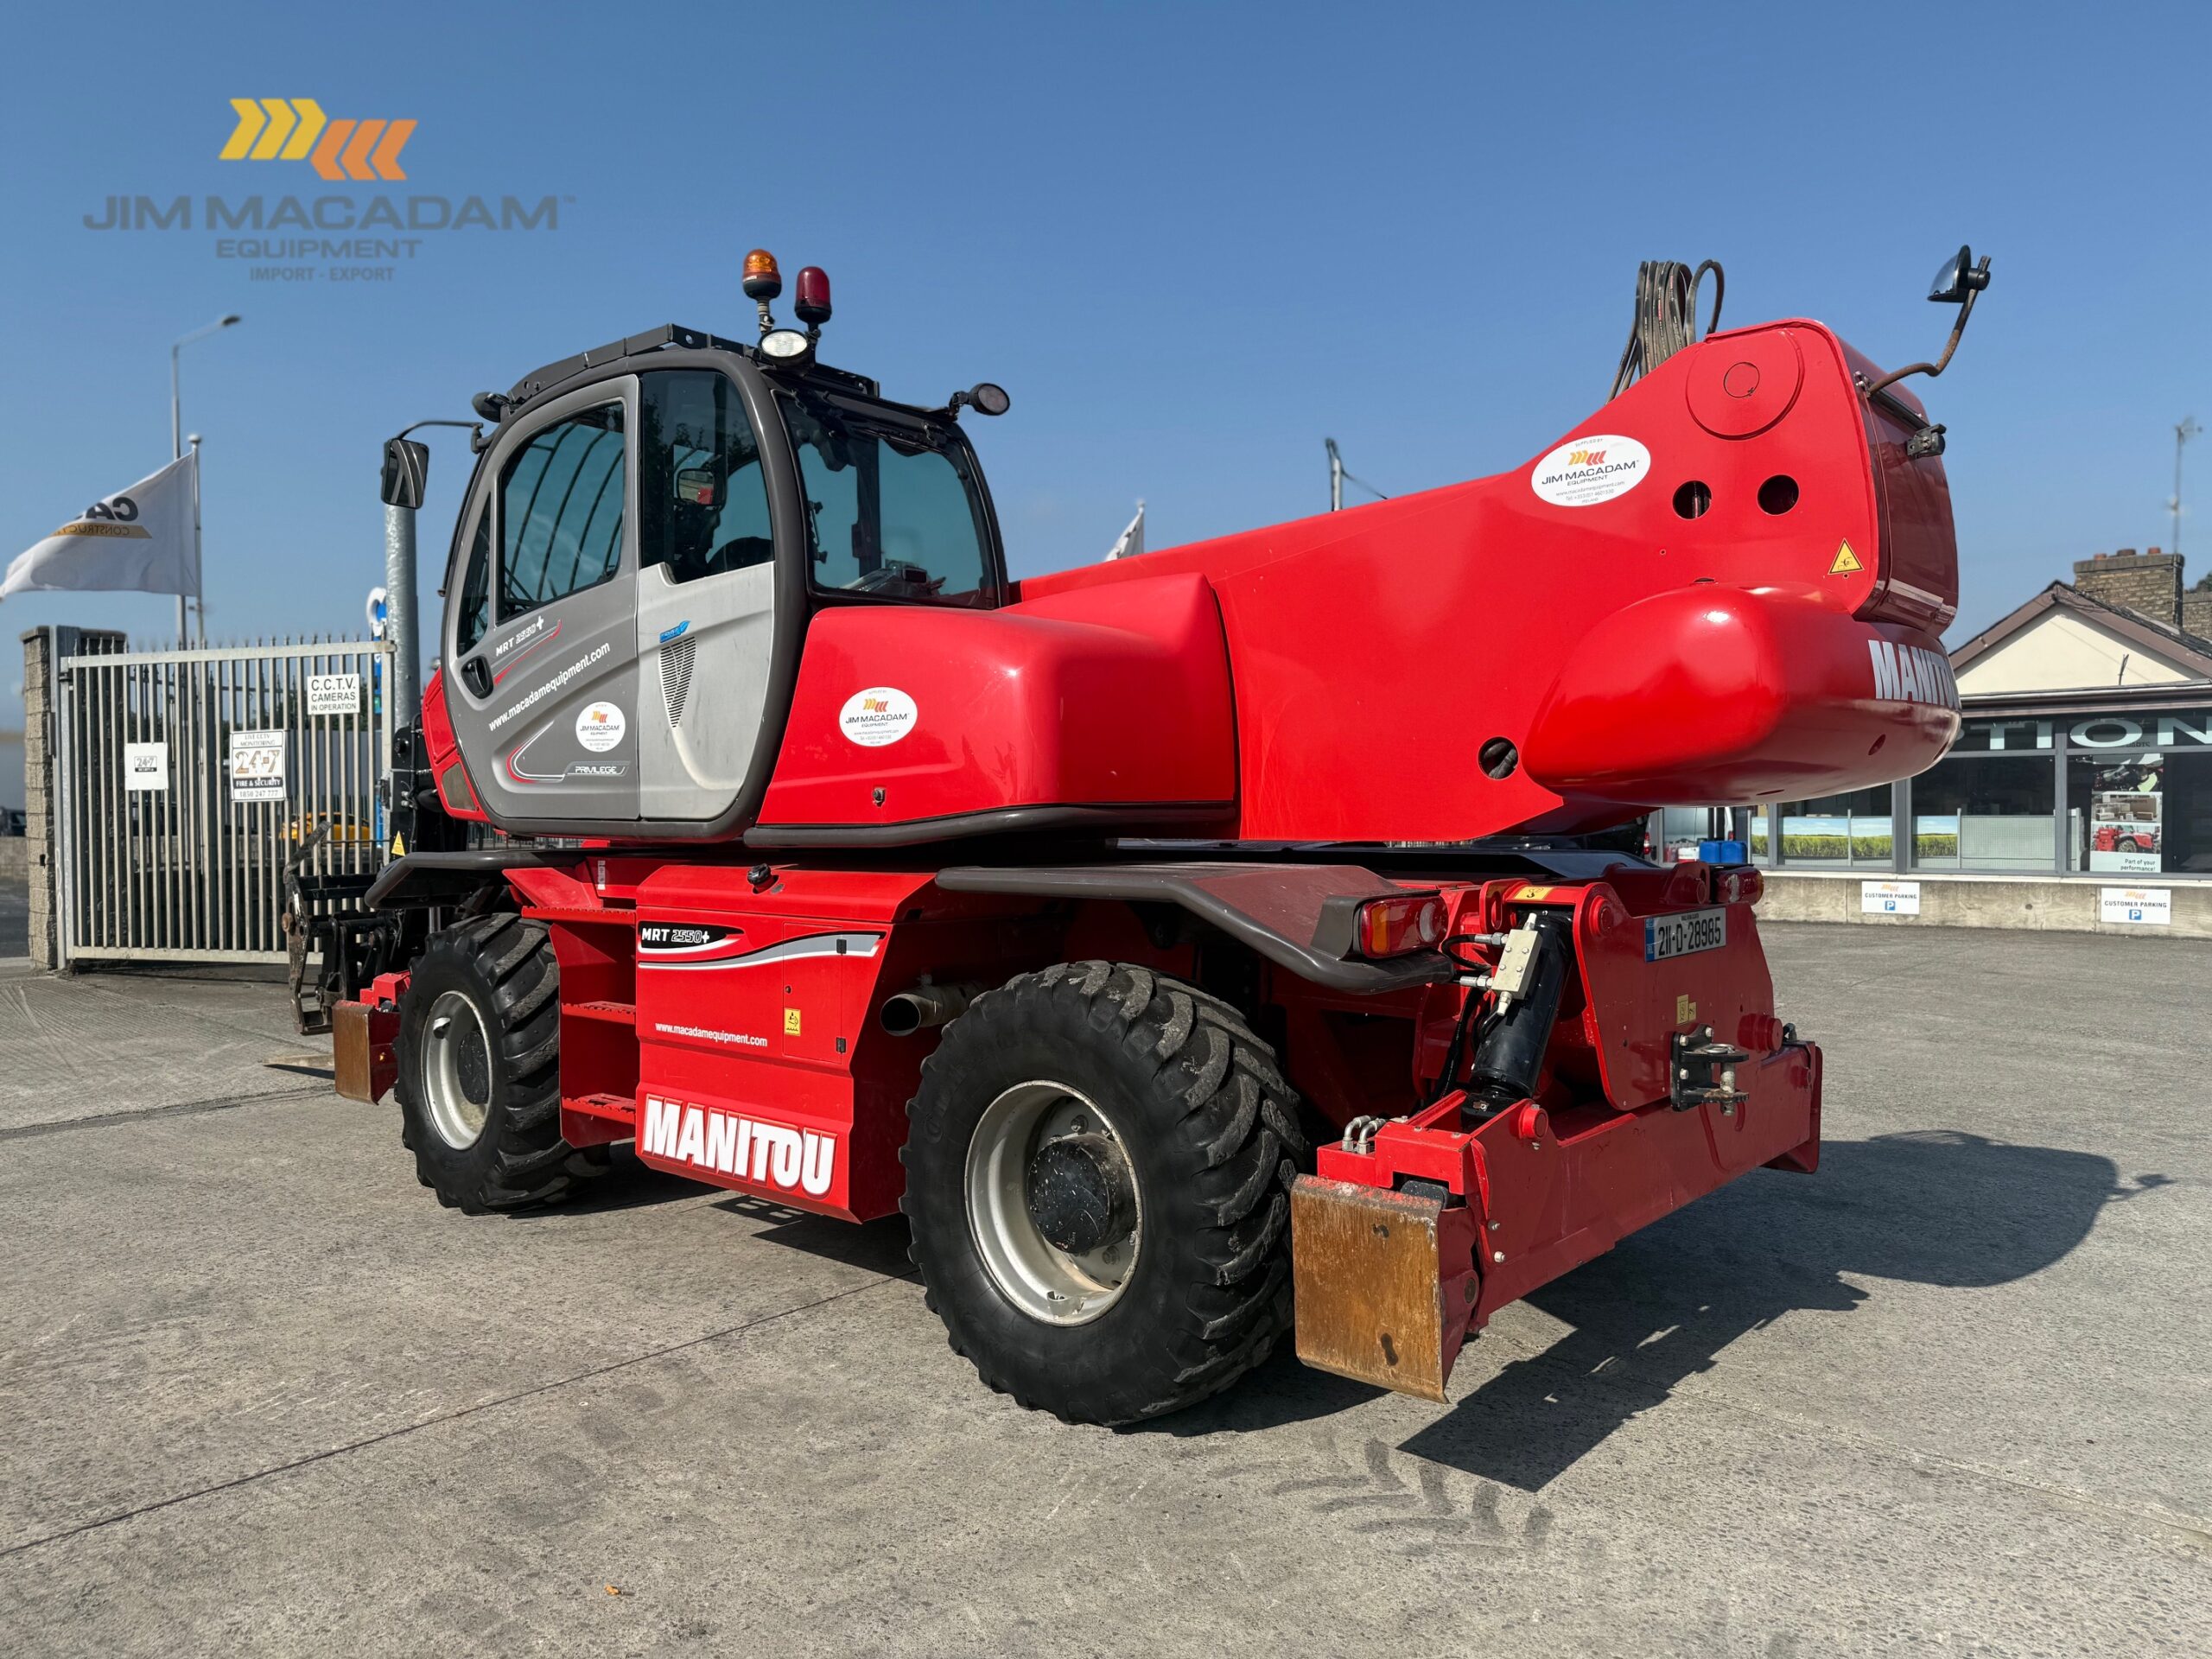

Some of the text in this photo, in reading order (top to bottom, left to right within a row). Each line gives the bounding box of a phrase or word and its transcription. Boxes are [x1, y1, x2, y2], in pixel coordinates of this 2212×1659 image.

[1541, 461, 1637, 485] JIM MACADAM
[1567, 475, 1608, 486] EQUIPMENT
[495, 637, 515, 657] MRT
[311, 677, 356, 691] C.C.T.V.
[488, 641, 611, 732] www.macadamequipment.com
[311, 692, 356, 702] CAMERAS
[860, 713, 908, 723] MACADAM
[1955, 716, 2212, 751] TION
[641, 927, 710, 944] MRT 2550+
[655, 1021, 768, 1047] www.macadamequipment.com
[643, 1098, 836, 1196] MANITOU
